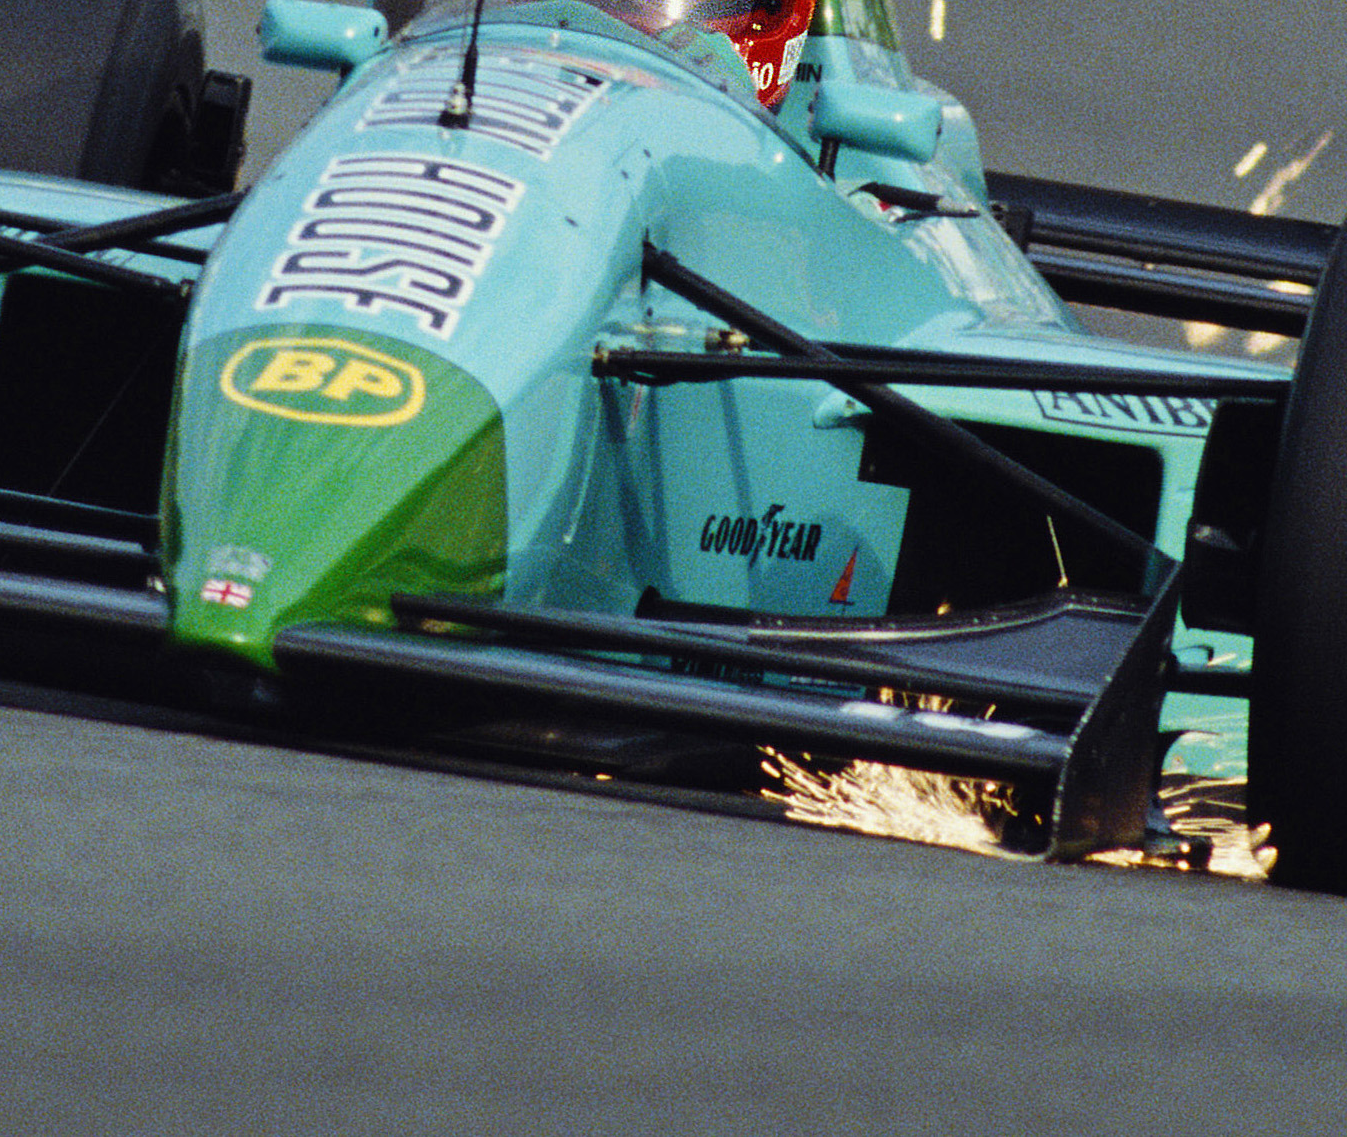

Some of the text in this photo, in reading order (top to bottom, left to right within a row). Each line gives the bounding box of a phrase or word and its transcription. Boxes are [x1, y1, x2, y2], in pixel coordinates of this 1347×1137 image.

[258, 47, 612, 338] EYTON HOUSE
[252, 350, 403, 401] BP
[700, 511, 822, 563] GOODYEAR
